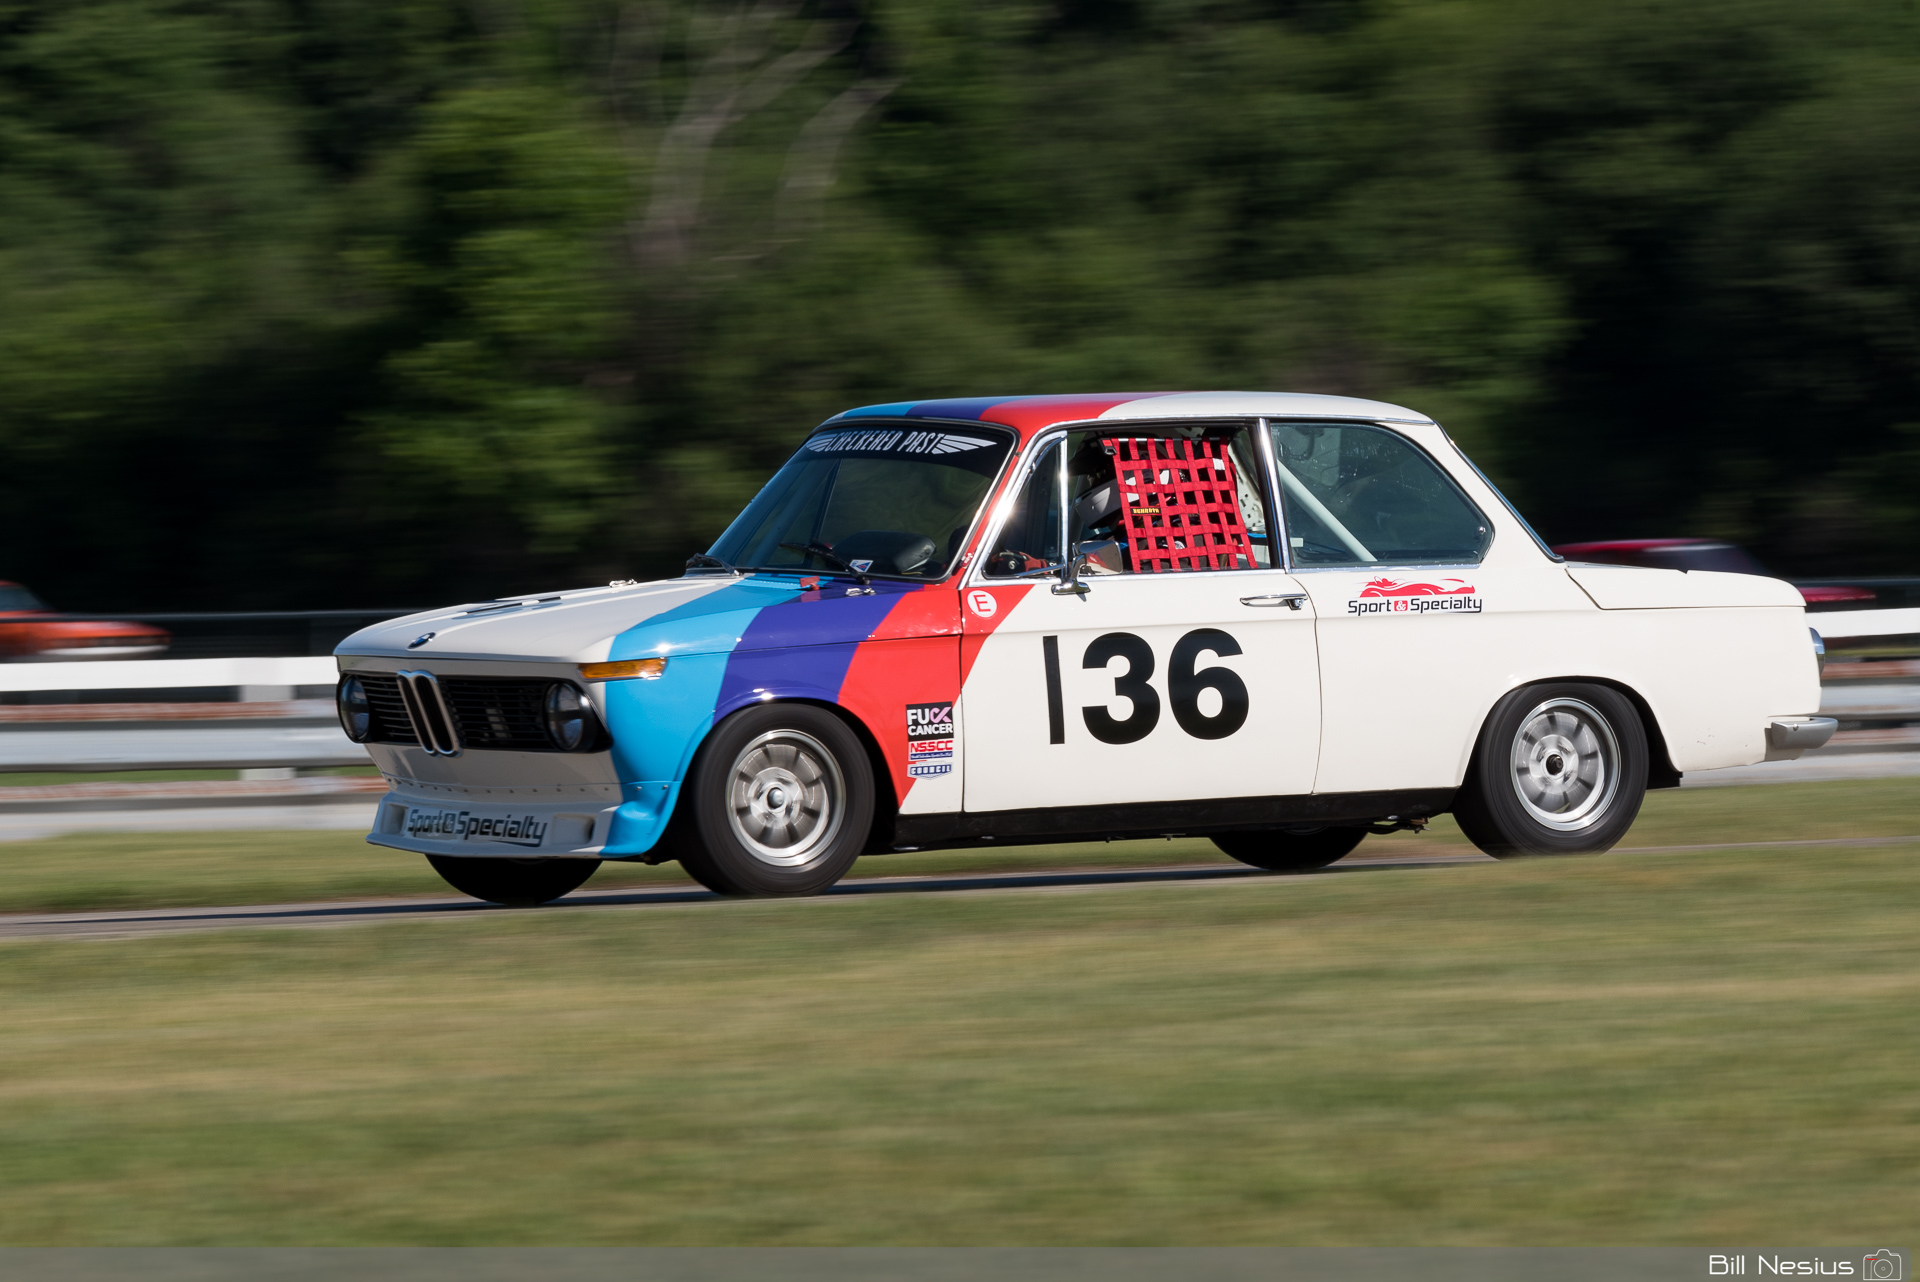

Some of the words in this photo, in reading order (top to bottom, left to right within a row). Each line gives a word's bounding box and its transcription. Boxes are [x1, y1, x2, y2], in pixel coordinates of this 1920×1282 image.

[826, 430, 904, 452] CHECKERED
[897, 431, 946, 454] PAST
[973, 594, 991, 612] E
[1348, 599, 1392, 616] Sport
[1394, 600, 1408, 612] &
[1410, 596, 1483, 614] Specialty
[1042, 628, 1250, 745] 136
[907, 723, 954, 736] CANCER
[911, 740, 953, 753] NSSCC
[407, 809, 442, 838] Sport
[455, 810, 548, 847] Specialty
